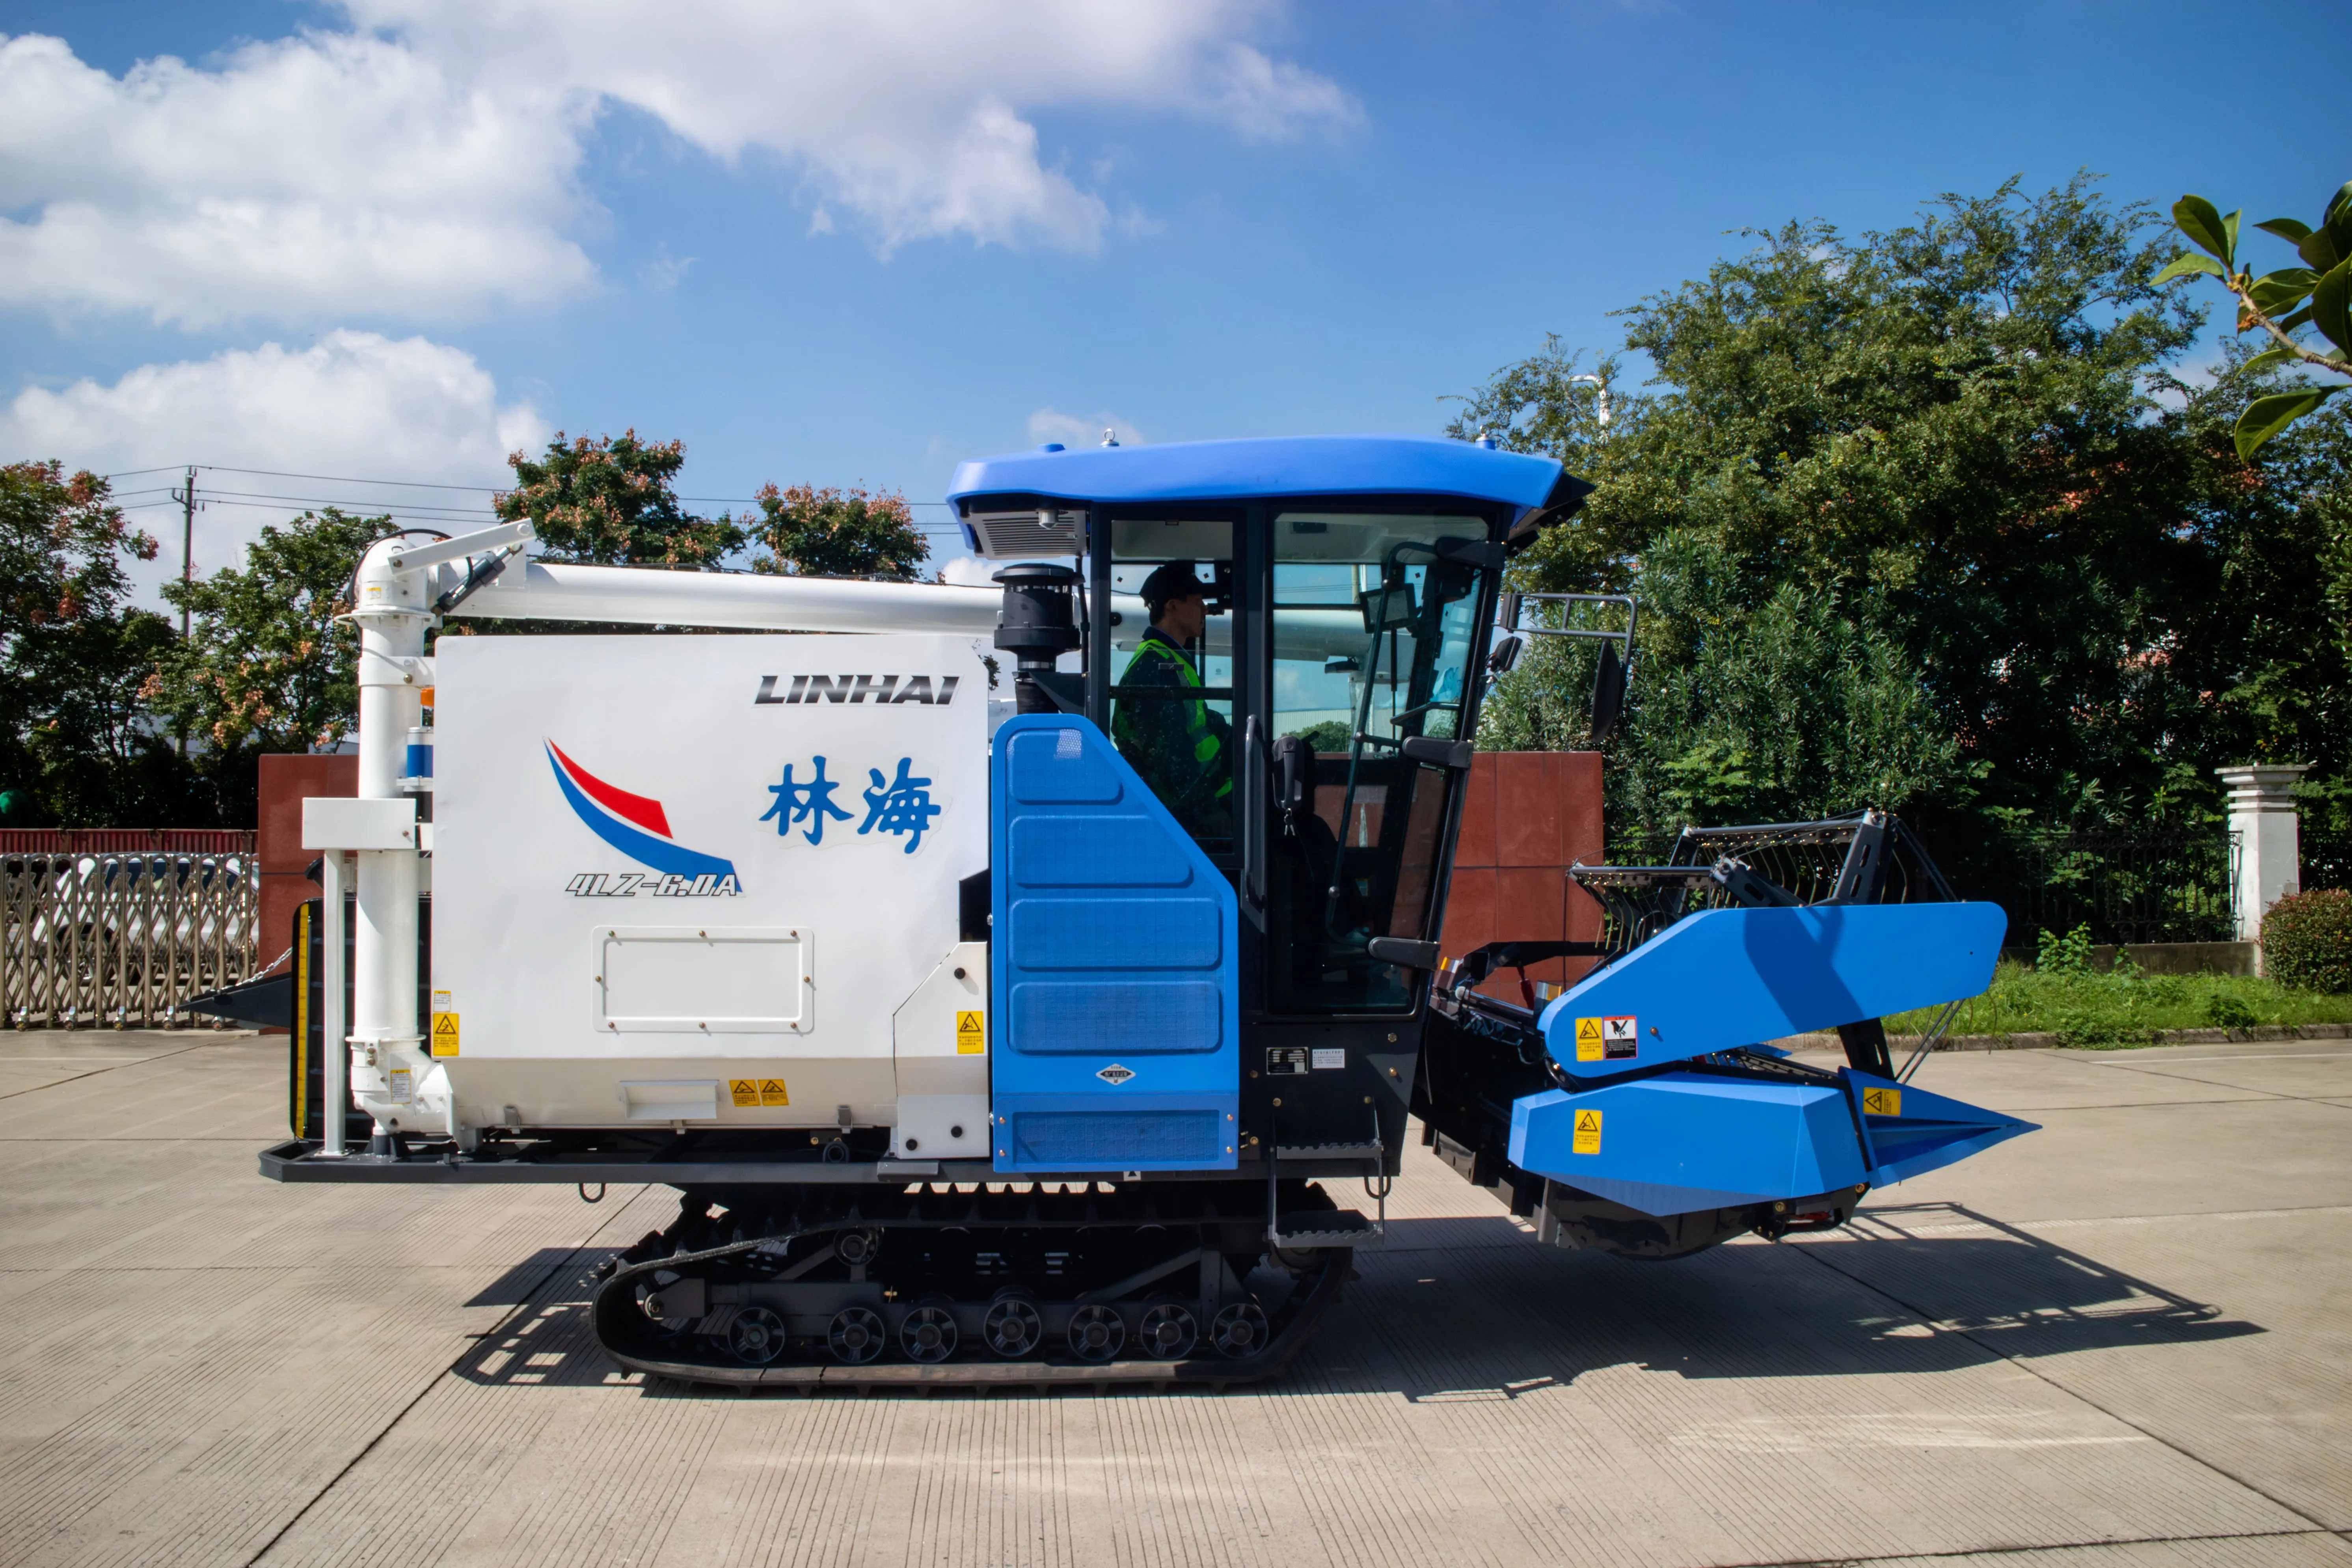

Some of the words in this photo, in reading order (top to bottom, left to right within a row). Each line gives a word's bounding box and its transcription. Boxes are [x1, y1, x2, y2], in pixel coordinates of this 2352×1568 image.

[754, 675, 959, 705] LINHAI
[759, 755, 941, 854] 林海
[565, 873, 737, 897] 4LZ-6.0A
